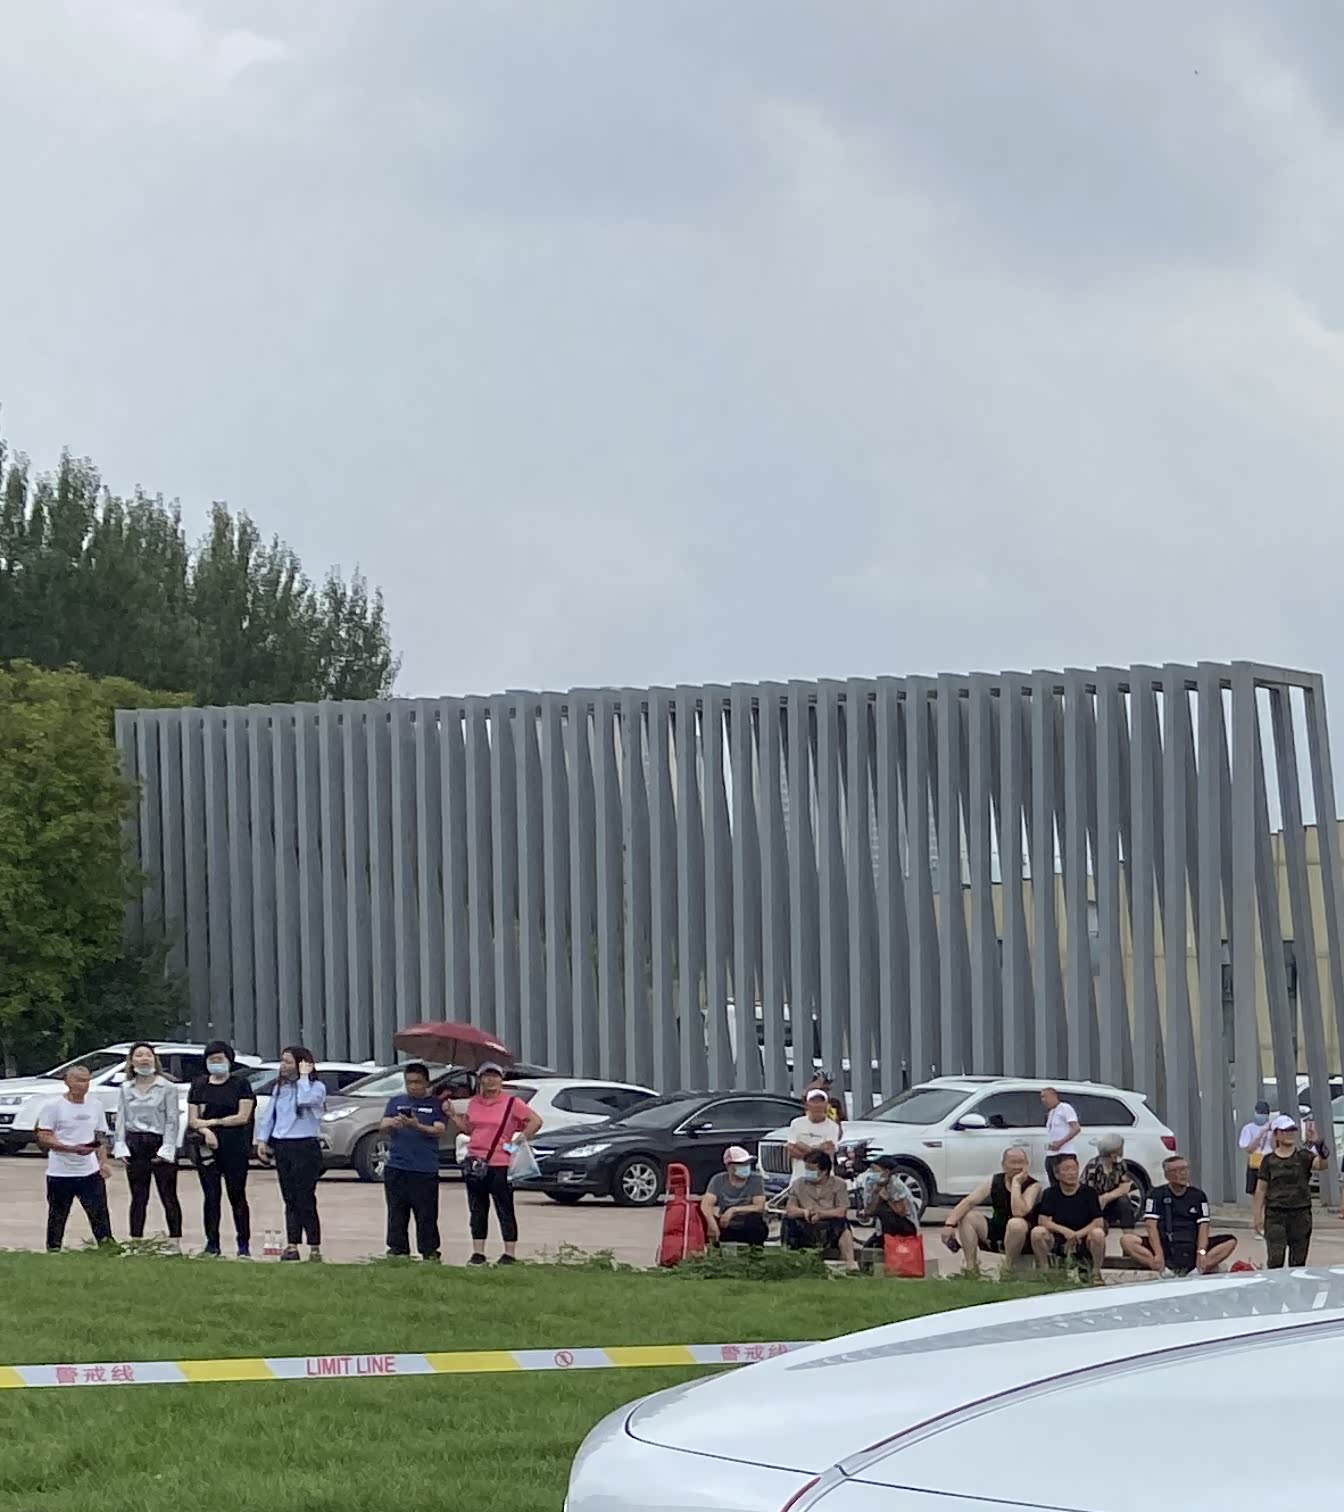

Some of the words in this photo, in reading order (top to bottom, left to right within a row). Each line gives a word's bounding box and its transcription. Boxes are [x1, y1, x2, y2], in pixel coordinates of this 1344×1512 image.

[55, 1365, 135, 1384] 警戒线
[306, 1356, 352, 1377] LIMIT
[356, 1355, 397, 1375] LINE
